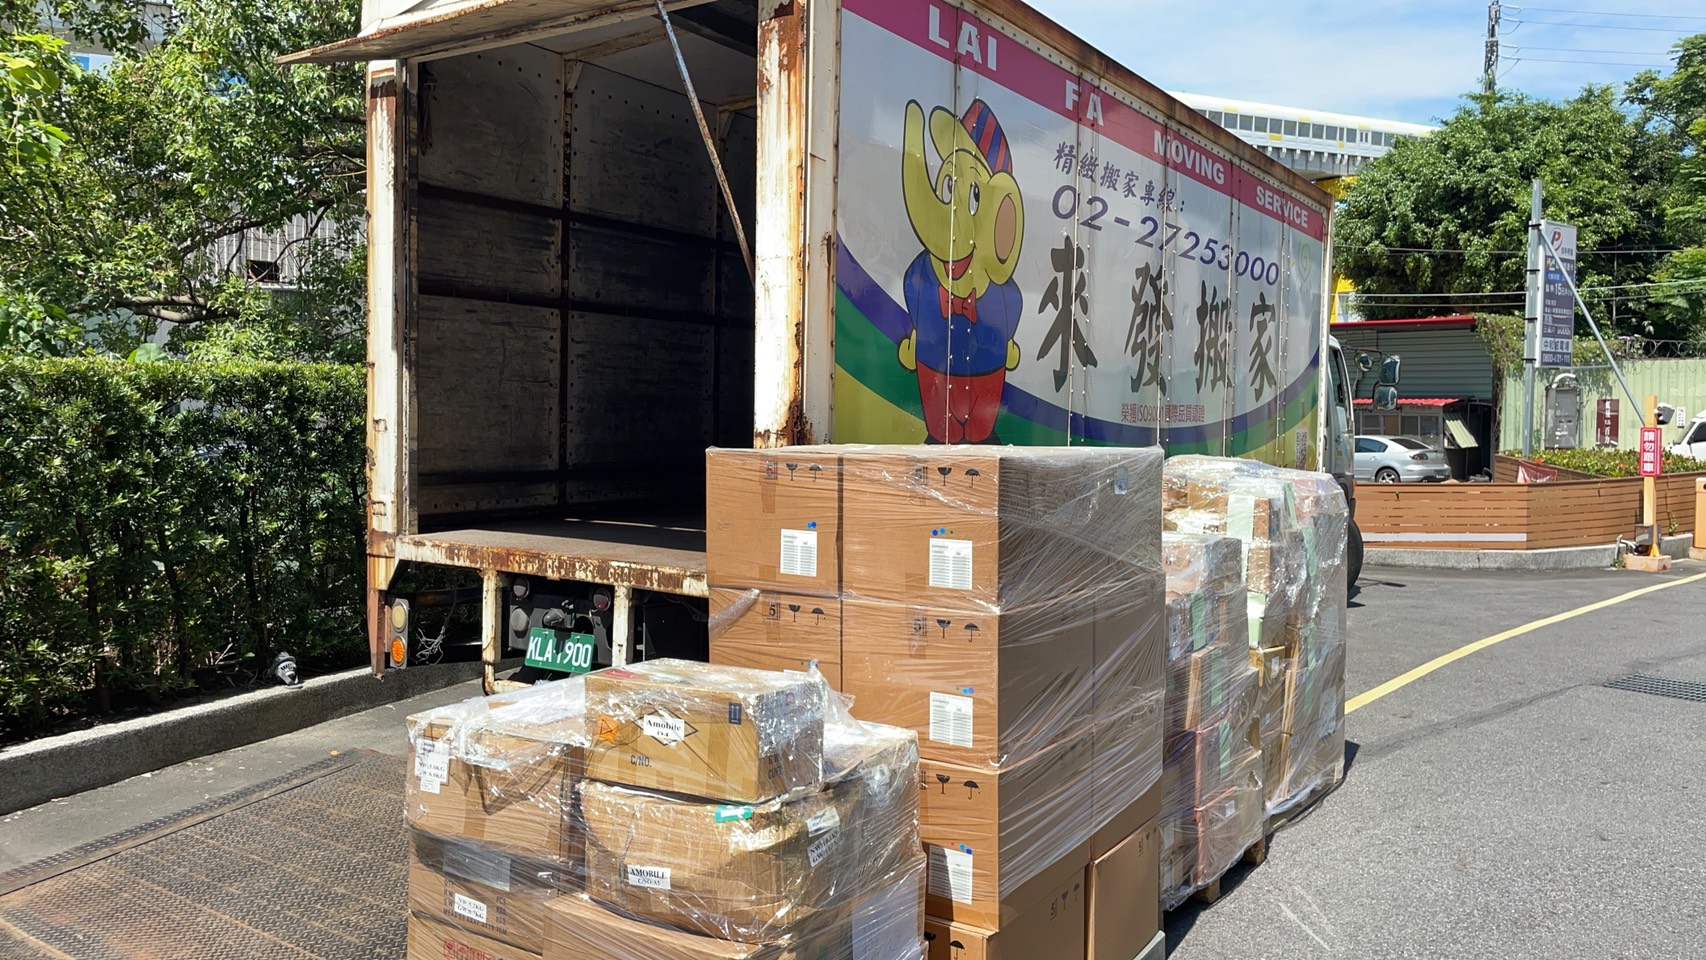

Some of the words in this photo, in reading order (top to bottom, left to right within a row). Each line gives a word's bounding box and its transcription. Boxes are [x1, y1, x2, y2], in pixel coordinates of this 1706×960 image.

[929, 4, 997, 72] LAI
[1065, 79, 1104, 127] FA
[1154, 130, 1225, 185] MOVING
[1256, 185, 1308, 228] SERVICE
[1052, 184, 1279, 286] 02-27253000
[646, 719, 682, 733] Amobile
[630, 867, 667, 879] AMOBILE
